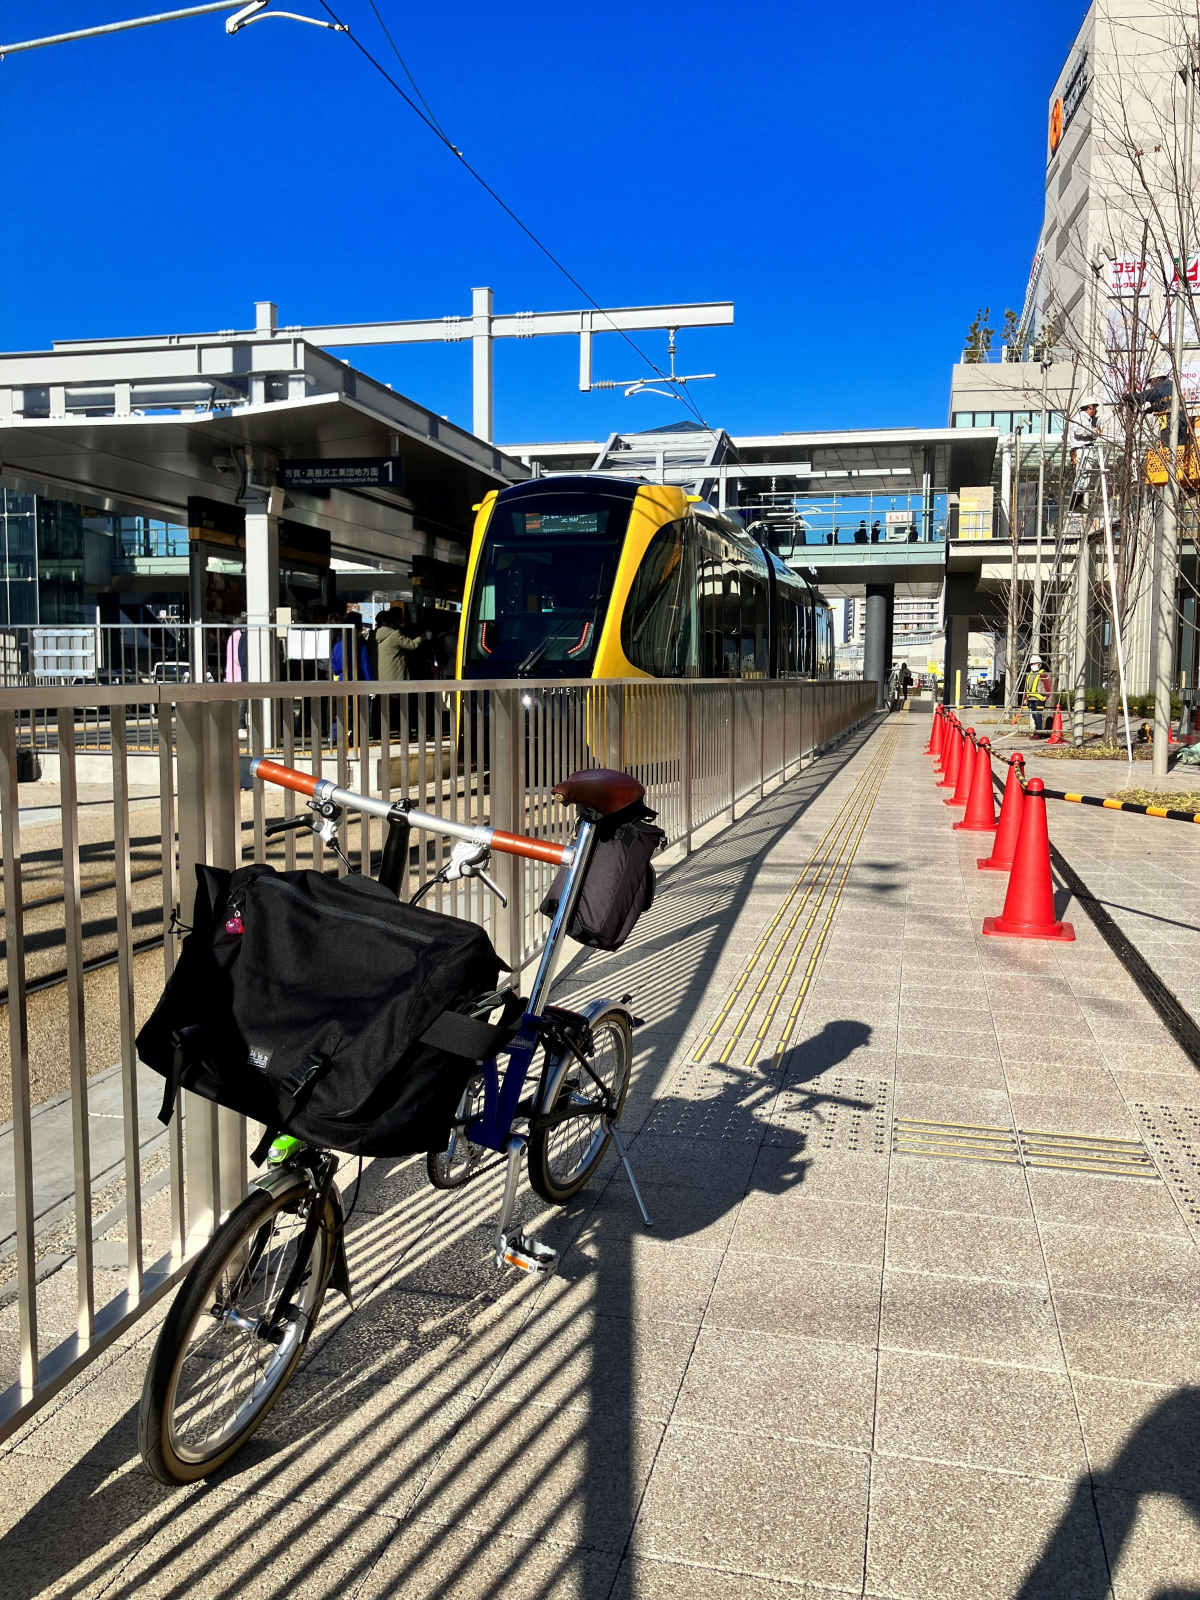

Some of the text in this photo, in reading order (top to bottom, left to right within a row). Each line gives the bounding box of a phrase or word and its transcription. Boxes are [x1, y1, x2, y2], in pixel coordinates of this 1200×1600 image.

[285, 467, 379, 478] 芳賀・高根沢工業団地方面
[383, 461, 393, 482] 1
